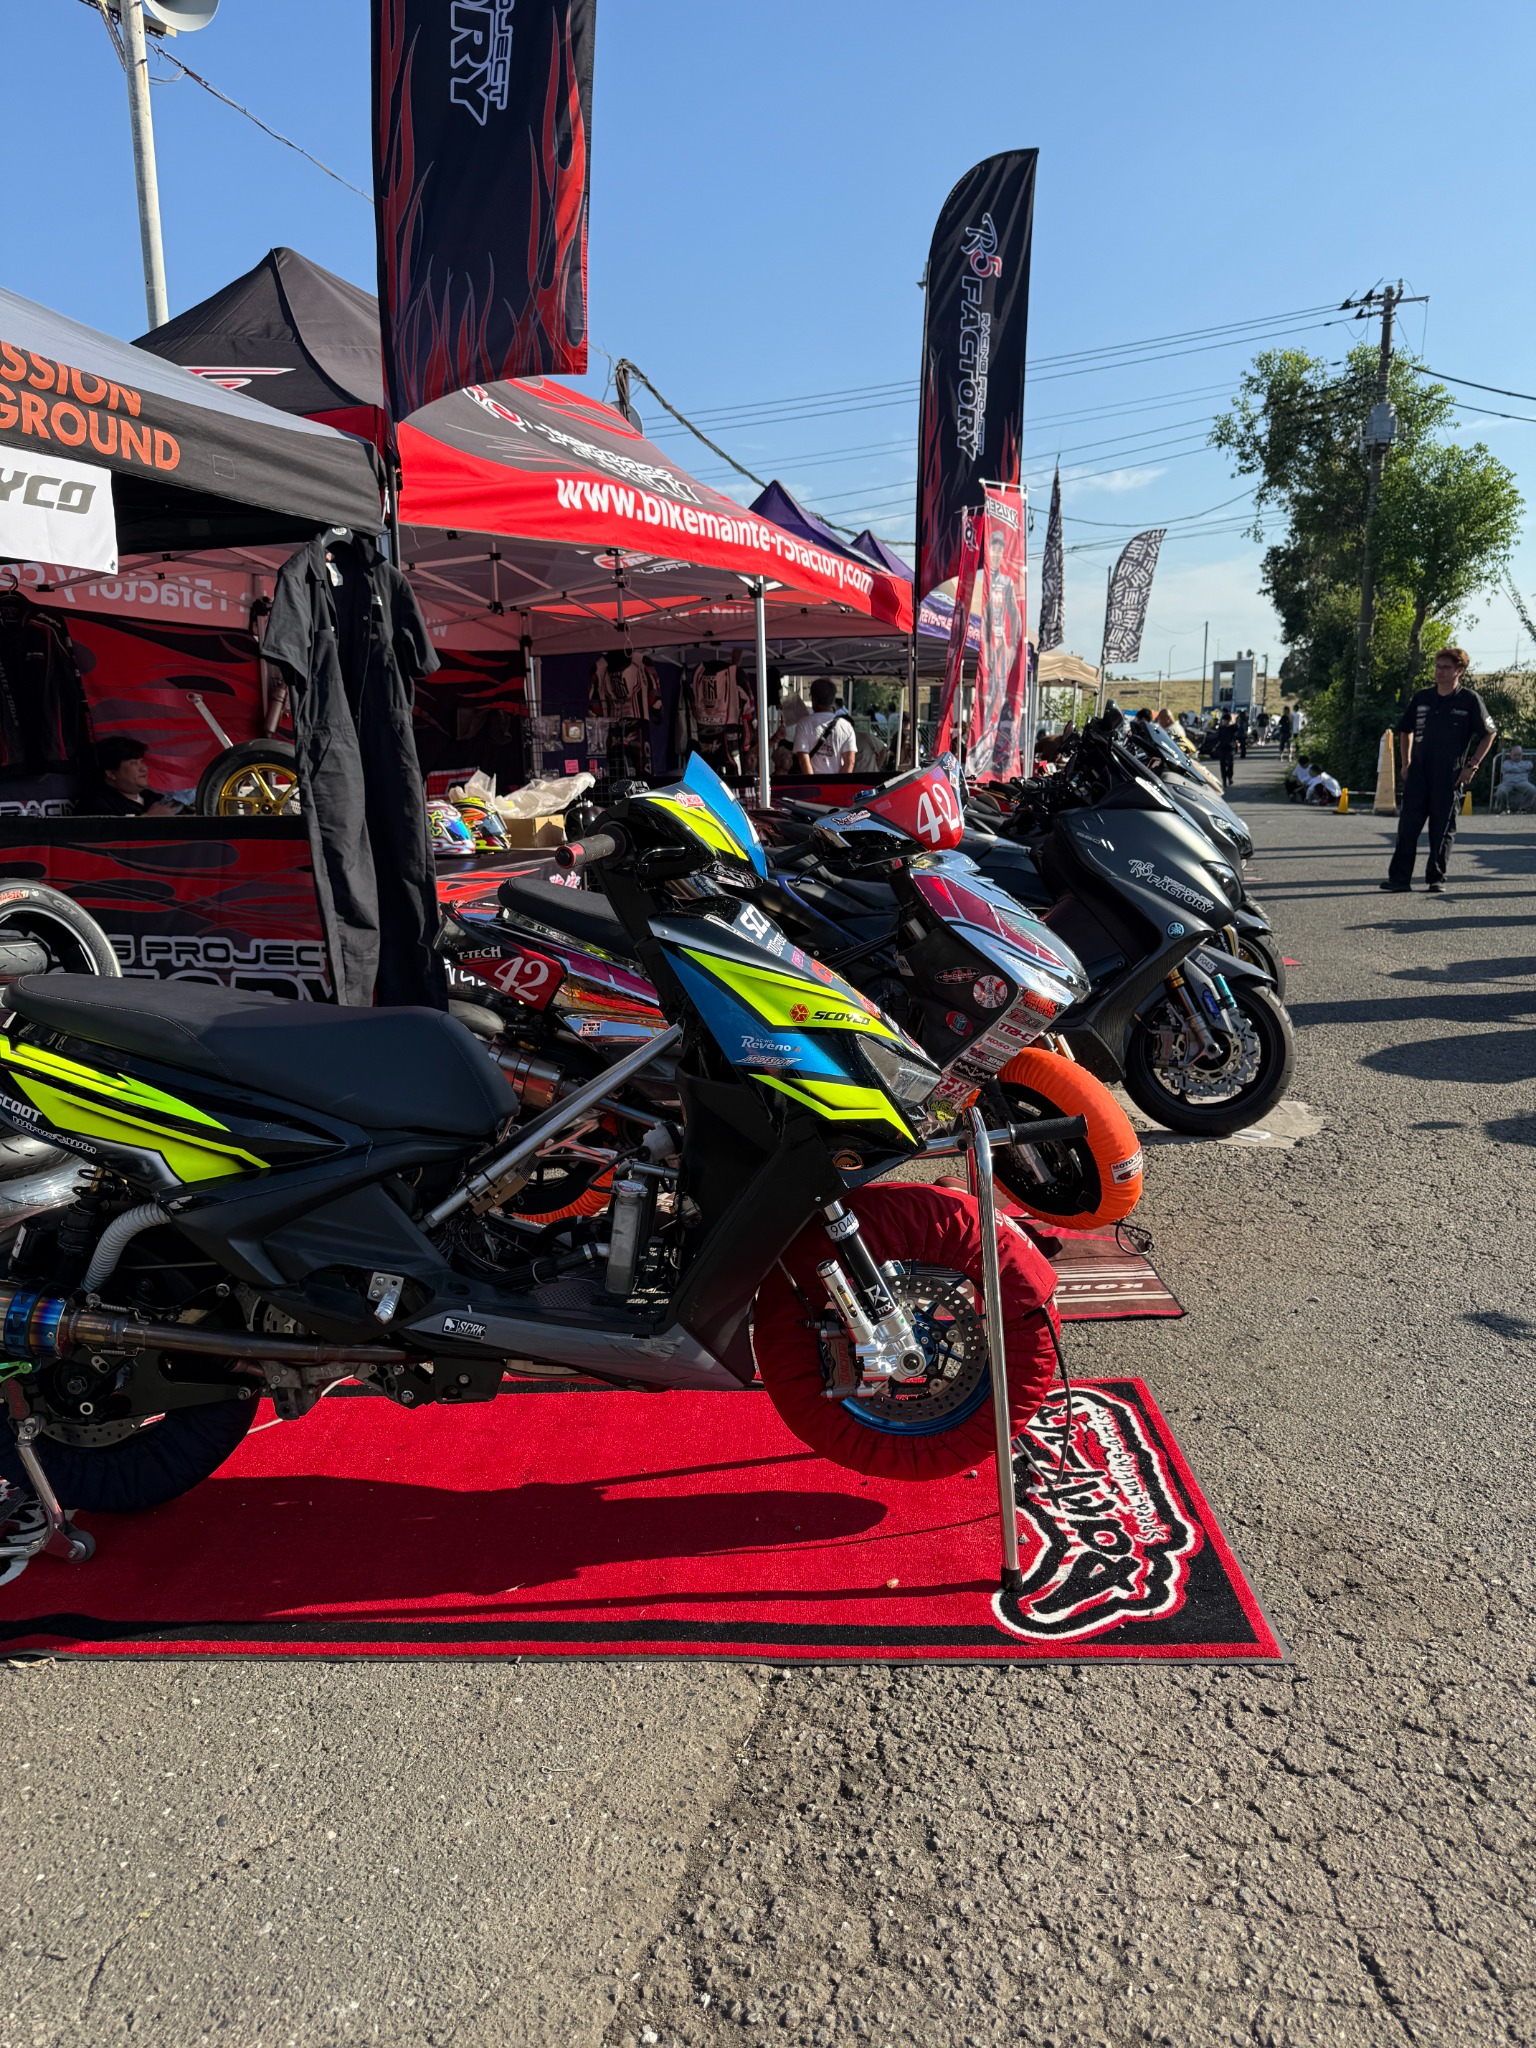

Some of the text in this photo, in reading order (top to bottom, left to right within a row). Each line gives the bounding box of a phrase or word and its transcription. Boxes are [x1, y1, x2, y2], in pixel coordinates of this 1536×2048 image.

[957, 212, 1002, 462] R5 FACTORY
[976, 312, 991, 456] RACING PROJECT
[555, 478, 874, 596] www.bikemainte-r5factory.com
[917, 783, 960, 843] 42
[53, 899, 78, 916] CST
[1146, 874, 1214, 913] FACTORY
[458, 946, 502, 960] T-TECH
[494, 956, 549, 1002] 42
[811, 1010, 870, 1025] SCOYCO
[740, 1035, 791, 1052] Reveno
[986, 1037, 1009, 1050] KOSO
[1095, 1408, 1166, 1543] Speed-making-artist
